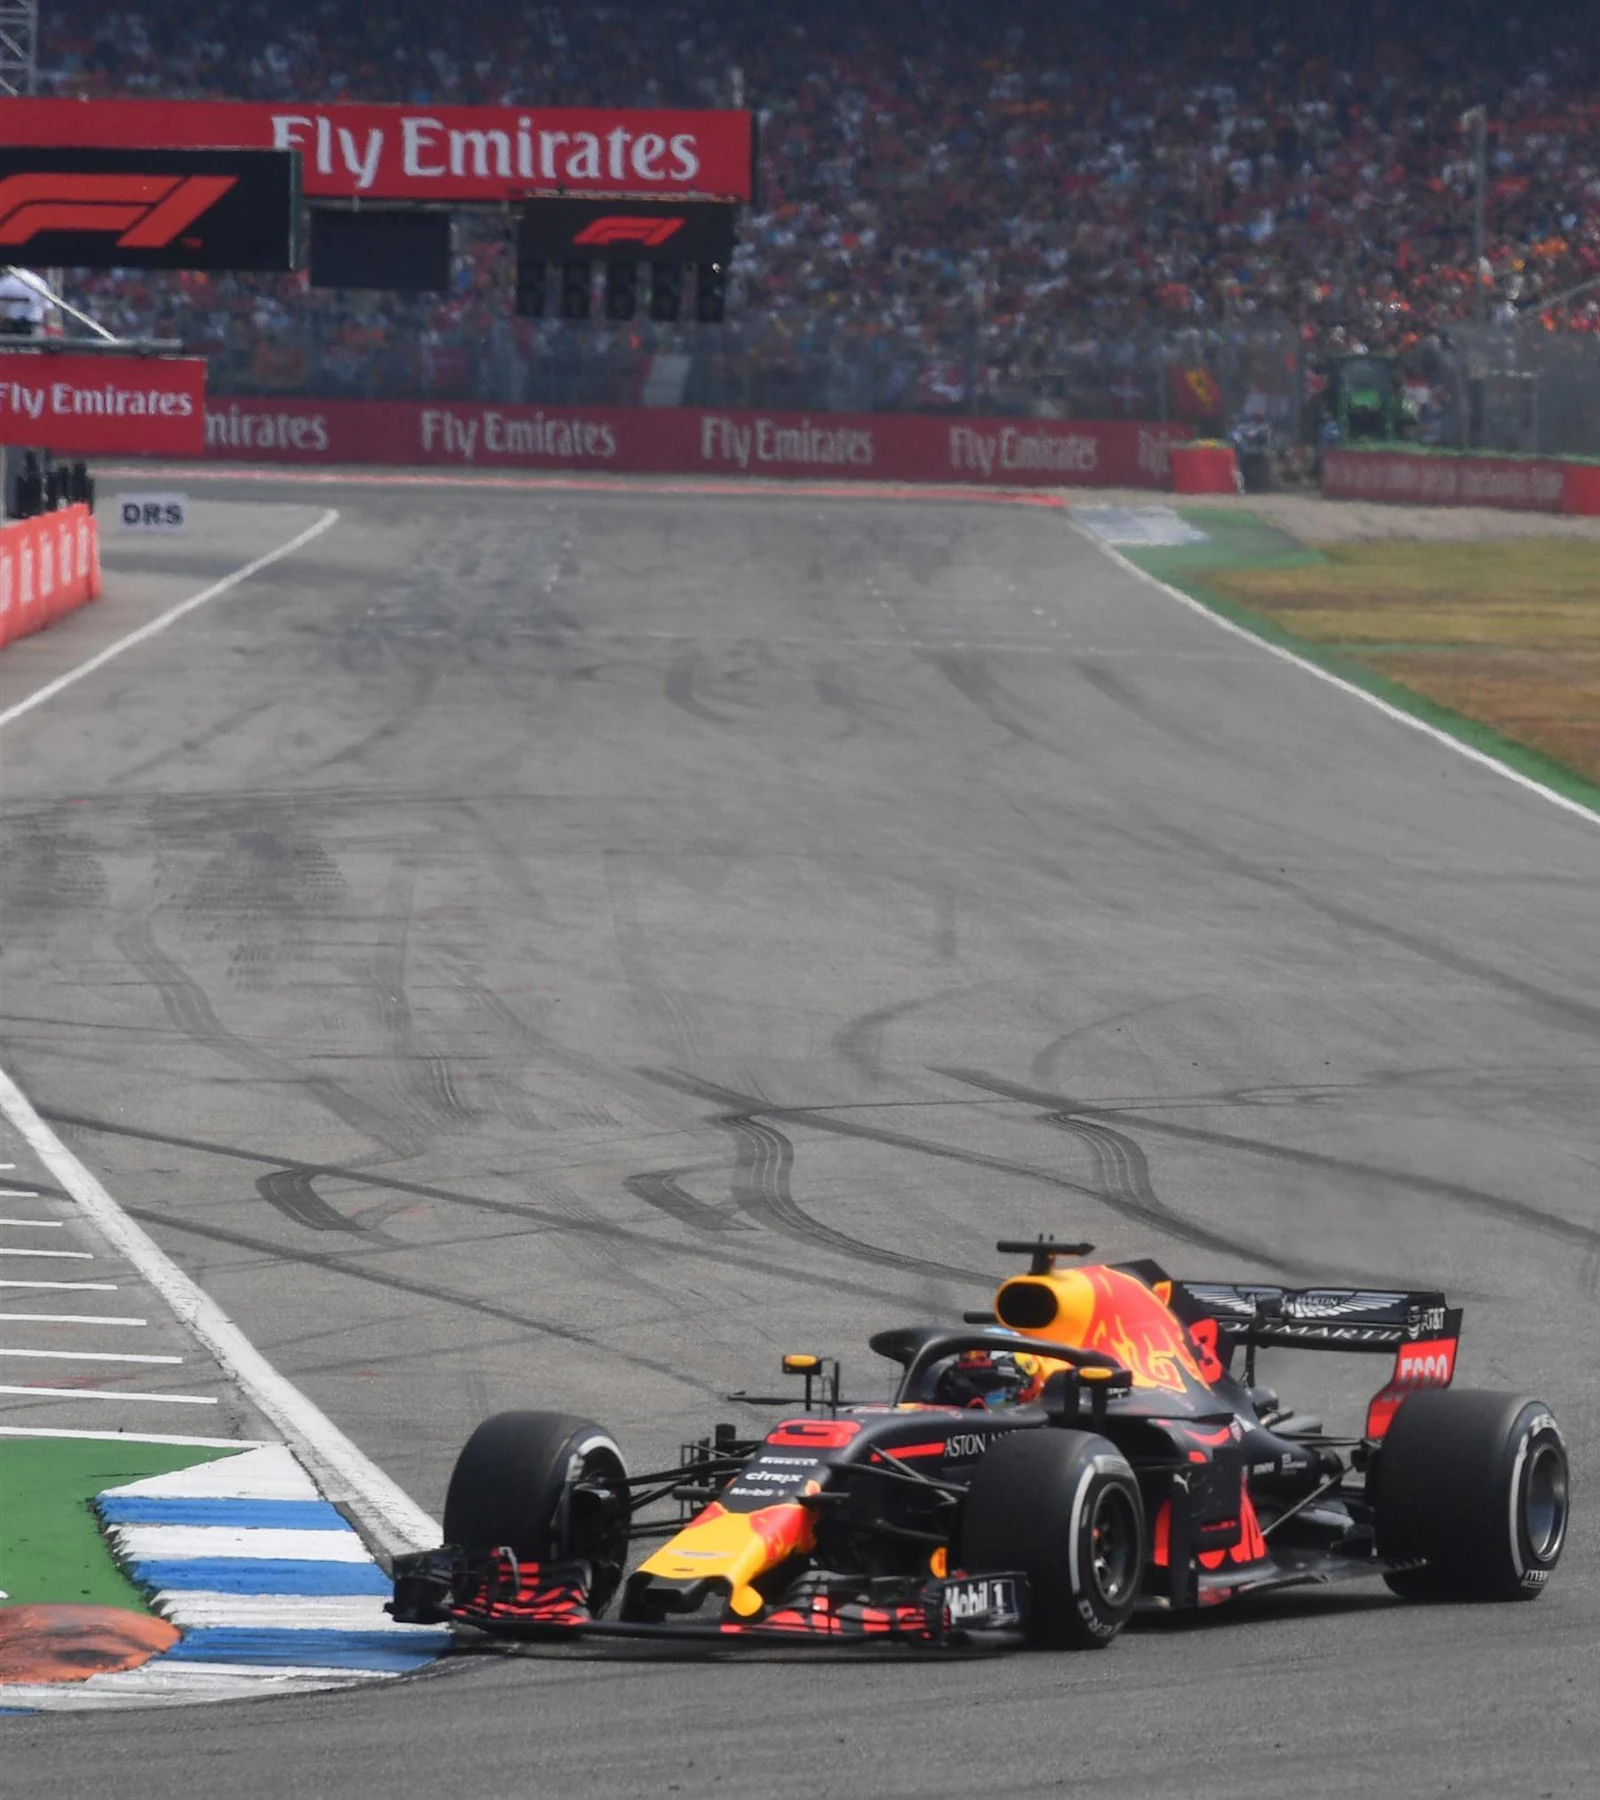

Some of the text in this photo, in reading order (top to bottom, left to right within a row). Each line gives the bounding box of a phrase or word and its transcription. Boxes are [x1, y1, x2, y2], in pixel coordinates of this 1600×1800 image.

[271, 115, 700, 189] Fly Emirates
[51, 383, 193, 417] Emirates
[205, 403, 328, 450] mirates
[420, 411, 617, 461] Fly Emirates
[701, 415, 875, 468] Fly Emirates
[121, 502, 184, 527] DRS
[944, 1433, 987, 1458] ASTON
[729, 1486, 774, 1498] Mobil
[945, 1582, 988, 1622] Mobil
